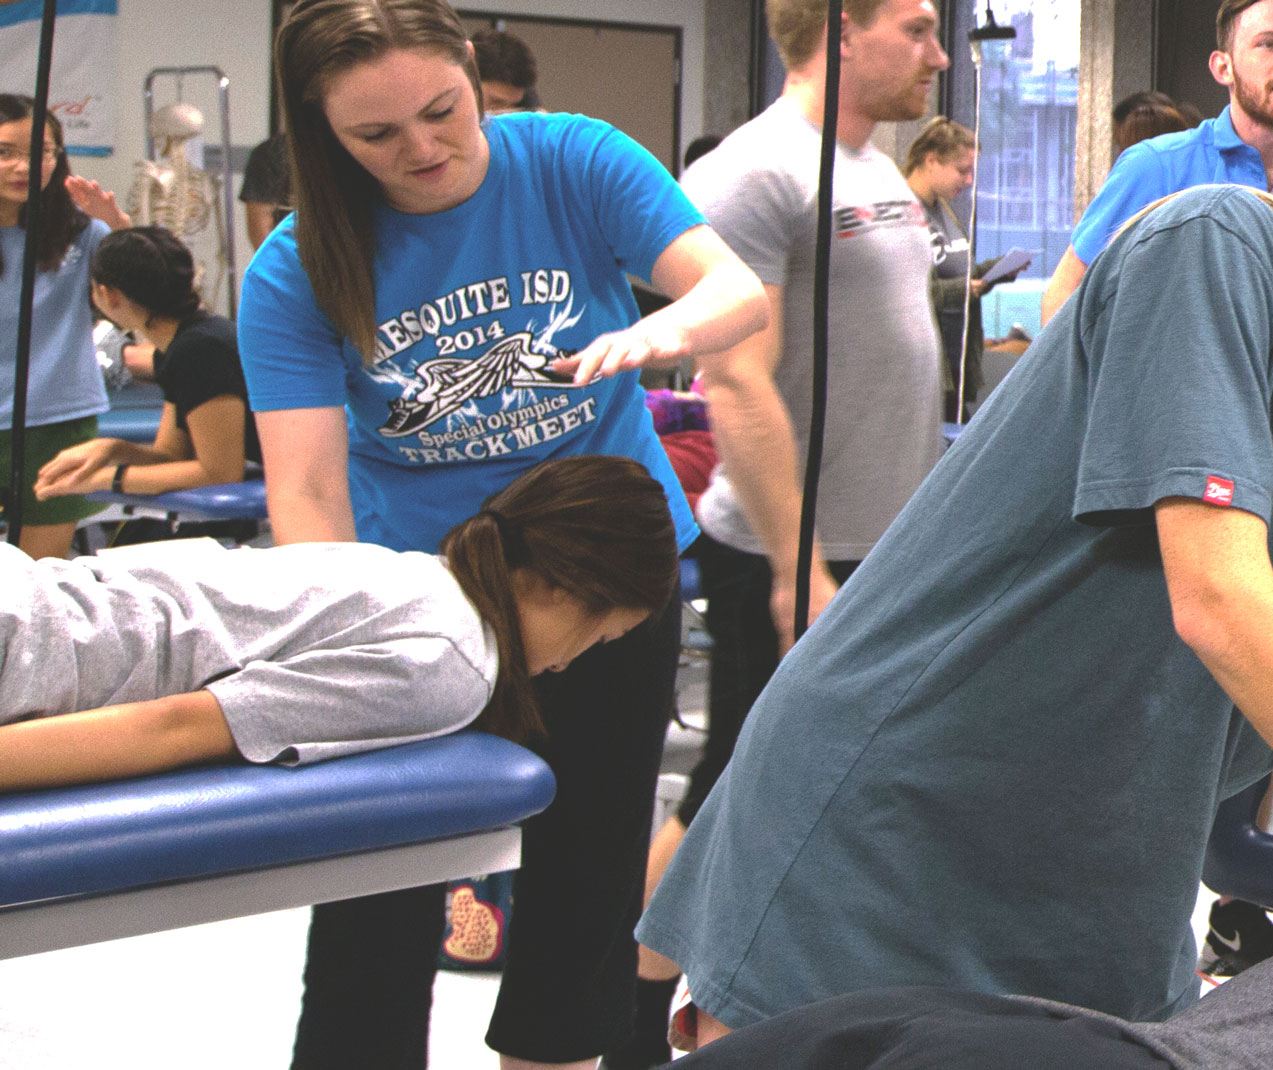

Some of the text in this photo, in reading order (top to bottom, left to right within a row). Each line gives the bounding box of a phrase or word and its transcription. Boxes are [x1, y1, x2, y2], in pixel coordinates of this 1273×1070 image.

[520, 269, 571, 305] ISD
[435, 320, 505, 356] 2014
[399, 397, 597, 464] TRACK MEET
[417, 393, 569, 449] Special Olympics
